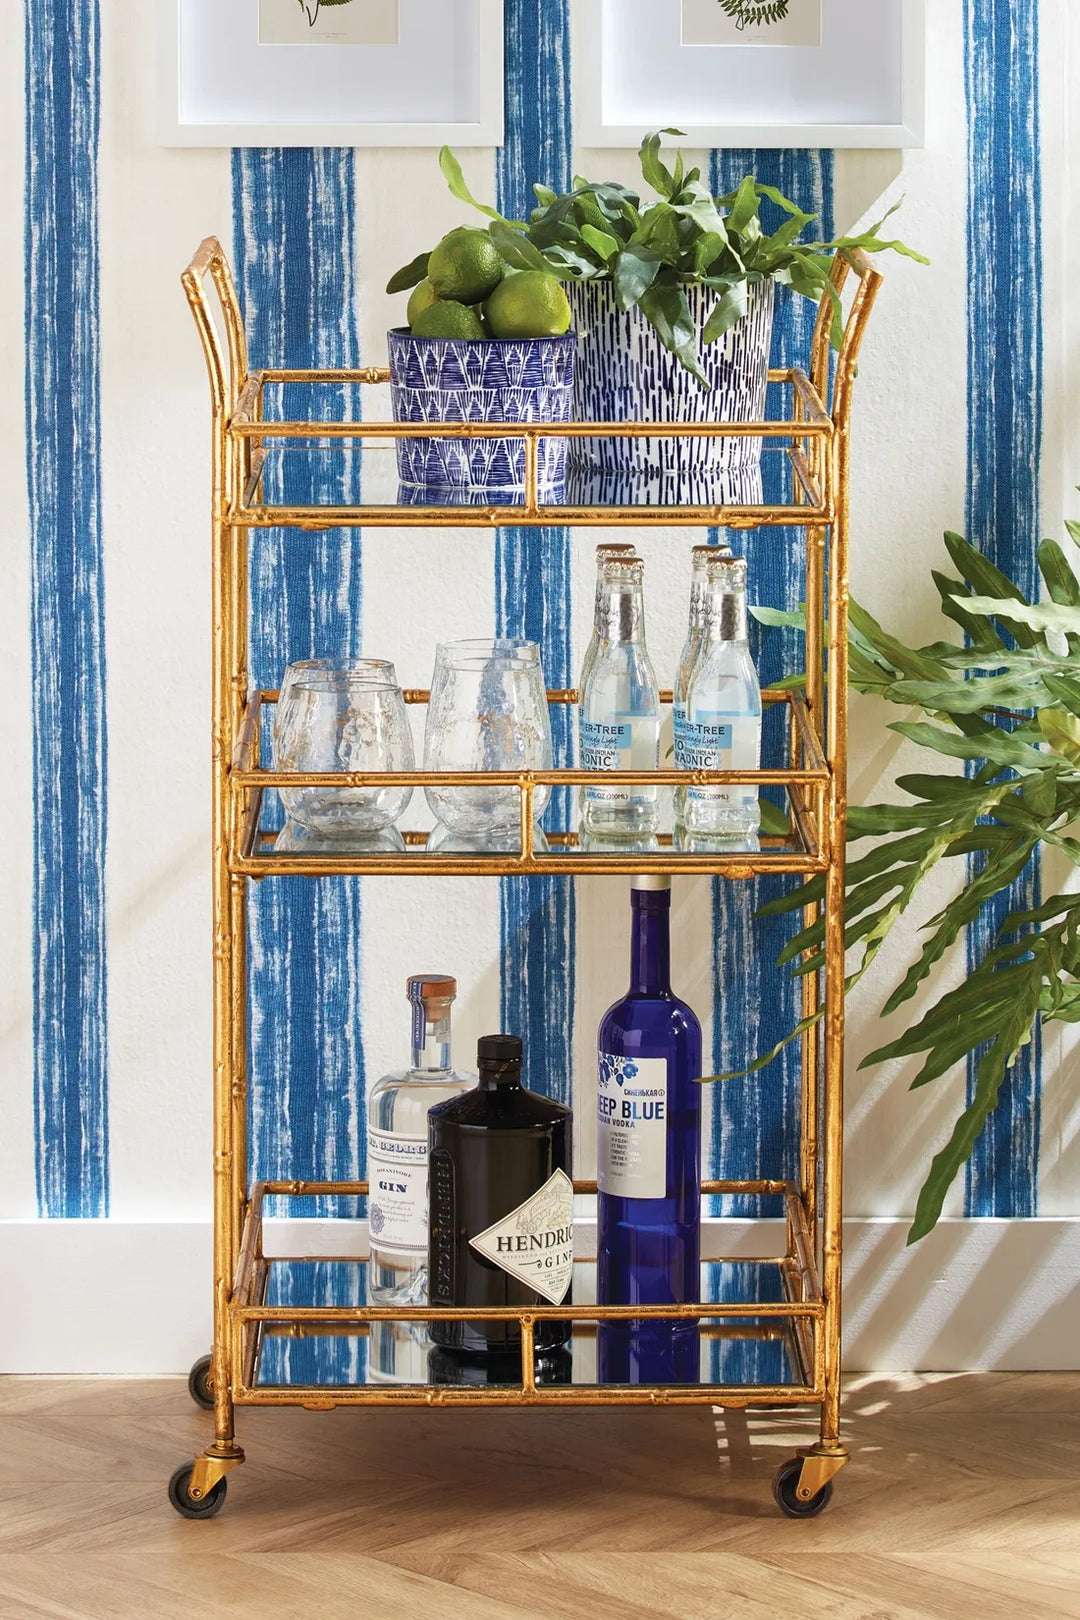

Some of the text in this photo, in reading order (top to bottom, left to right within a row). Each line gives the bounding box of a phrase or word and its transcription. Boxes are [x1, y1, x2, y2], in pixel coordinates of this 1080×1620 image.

[598, 1093, 616, 1116] EEP
[622, 1100, 664, 1120] BLUE
[612, 1118, 635, 1128] VODKA
[378, 1180, 408, 1193] GIN
[545, 1250, 573, 1268] GIN
